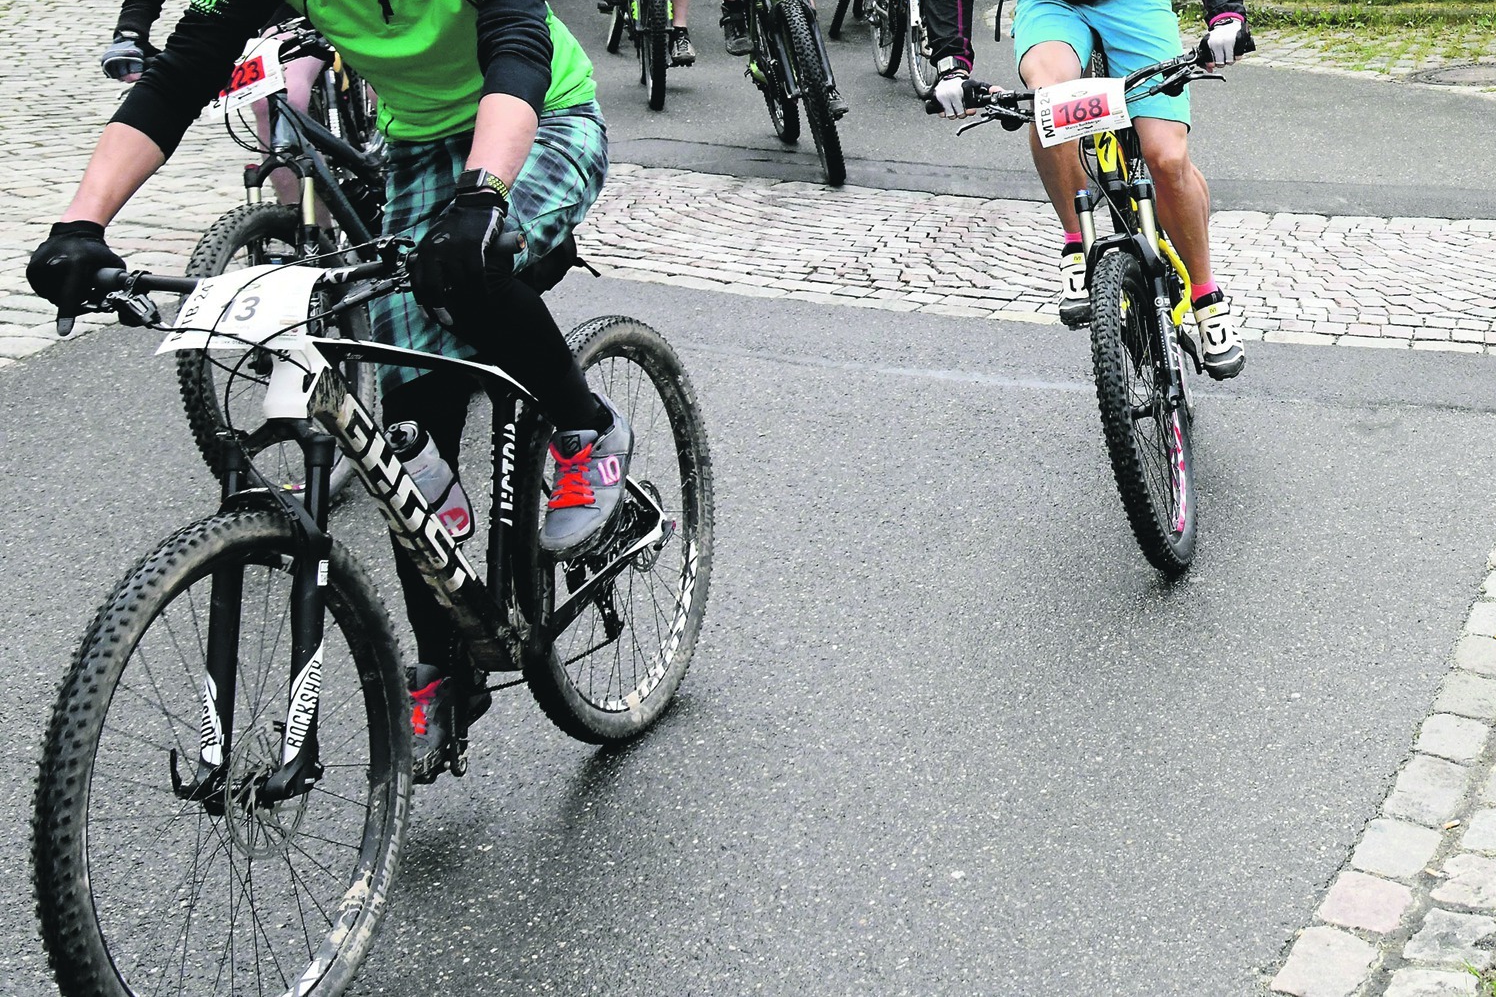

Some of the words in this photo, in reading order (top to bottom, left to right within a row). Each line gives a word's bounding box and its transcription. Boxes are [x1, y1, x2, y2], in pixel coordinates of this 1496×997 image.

[1041, 108, 1056, 138] MTB
[1058, 98, 1103, 124] 168
[220, 296, 260, 323] 13
[337, 392, 478, 593] GHOST
[286, 659, 322, 748] ROCKSHOX
